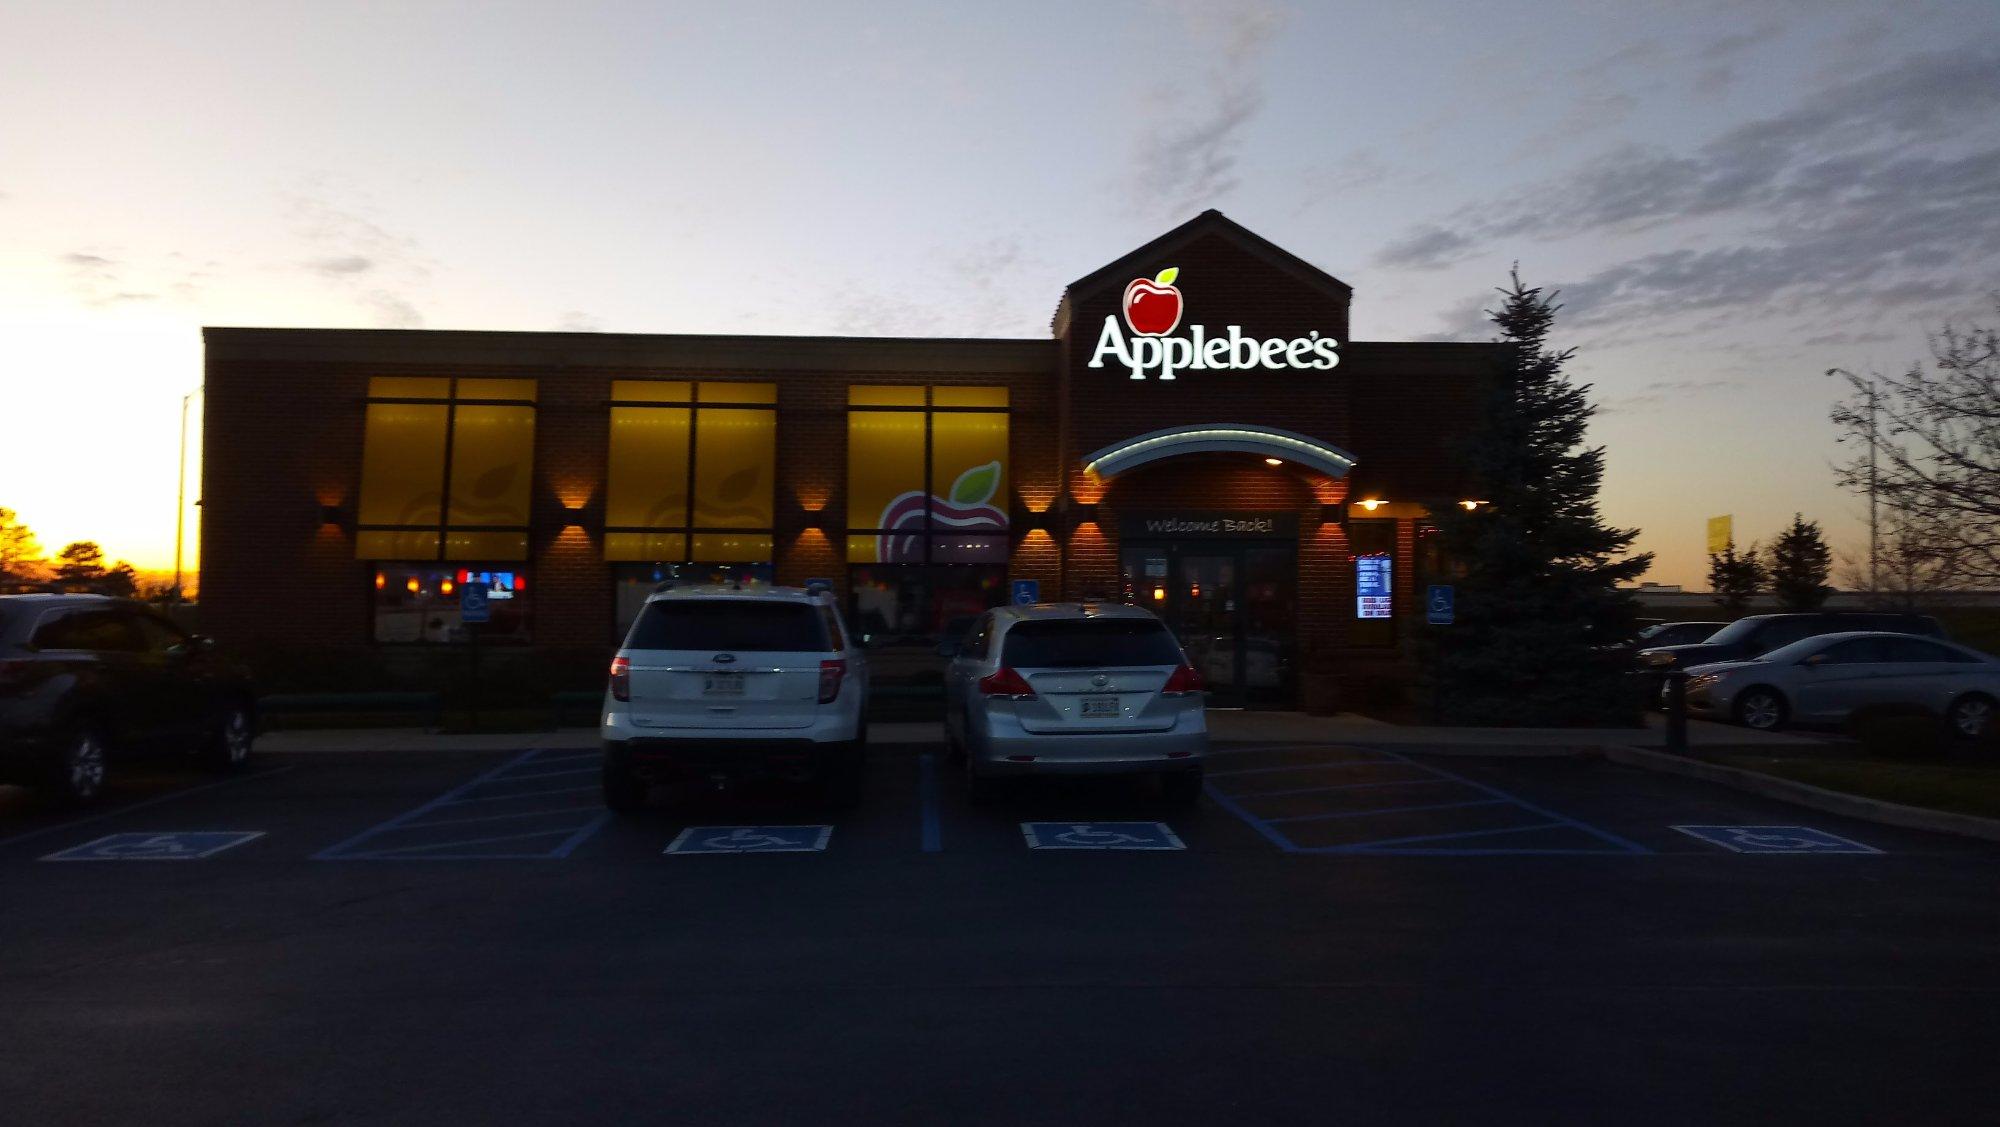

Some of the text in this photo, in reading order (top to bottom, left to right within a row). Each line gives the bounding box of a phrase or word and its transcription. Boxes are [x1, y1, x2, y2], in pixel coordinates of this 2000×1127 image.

[1087, 315, 1340, 380] Applebee's
[1145, 517, 1273, 533] Welcome Back!
